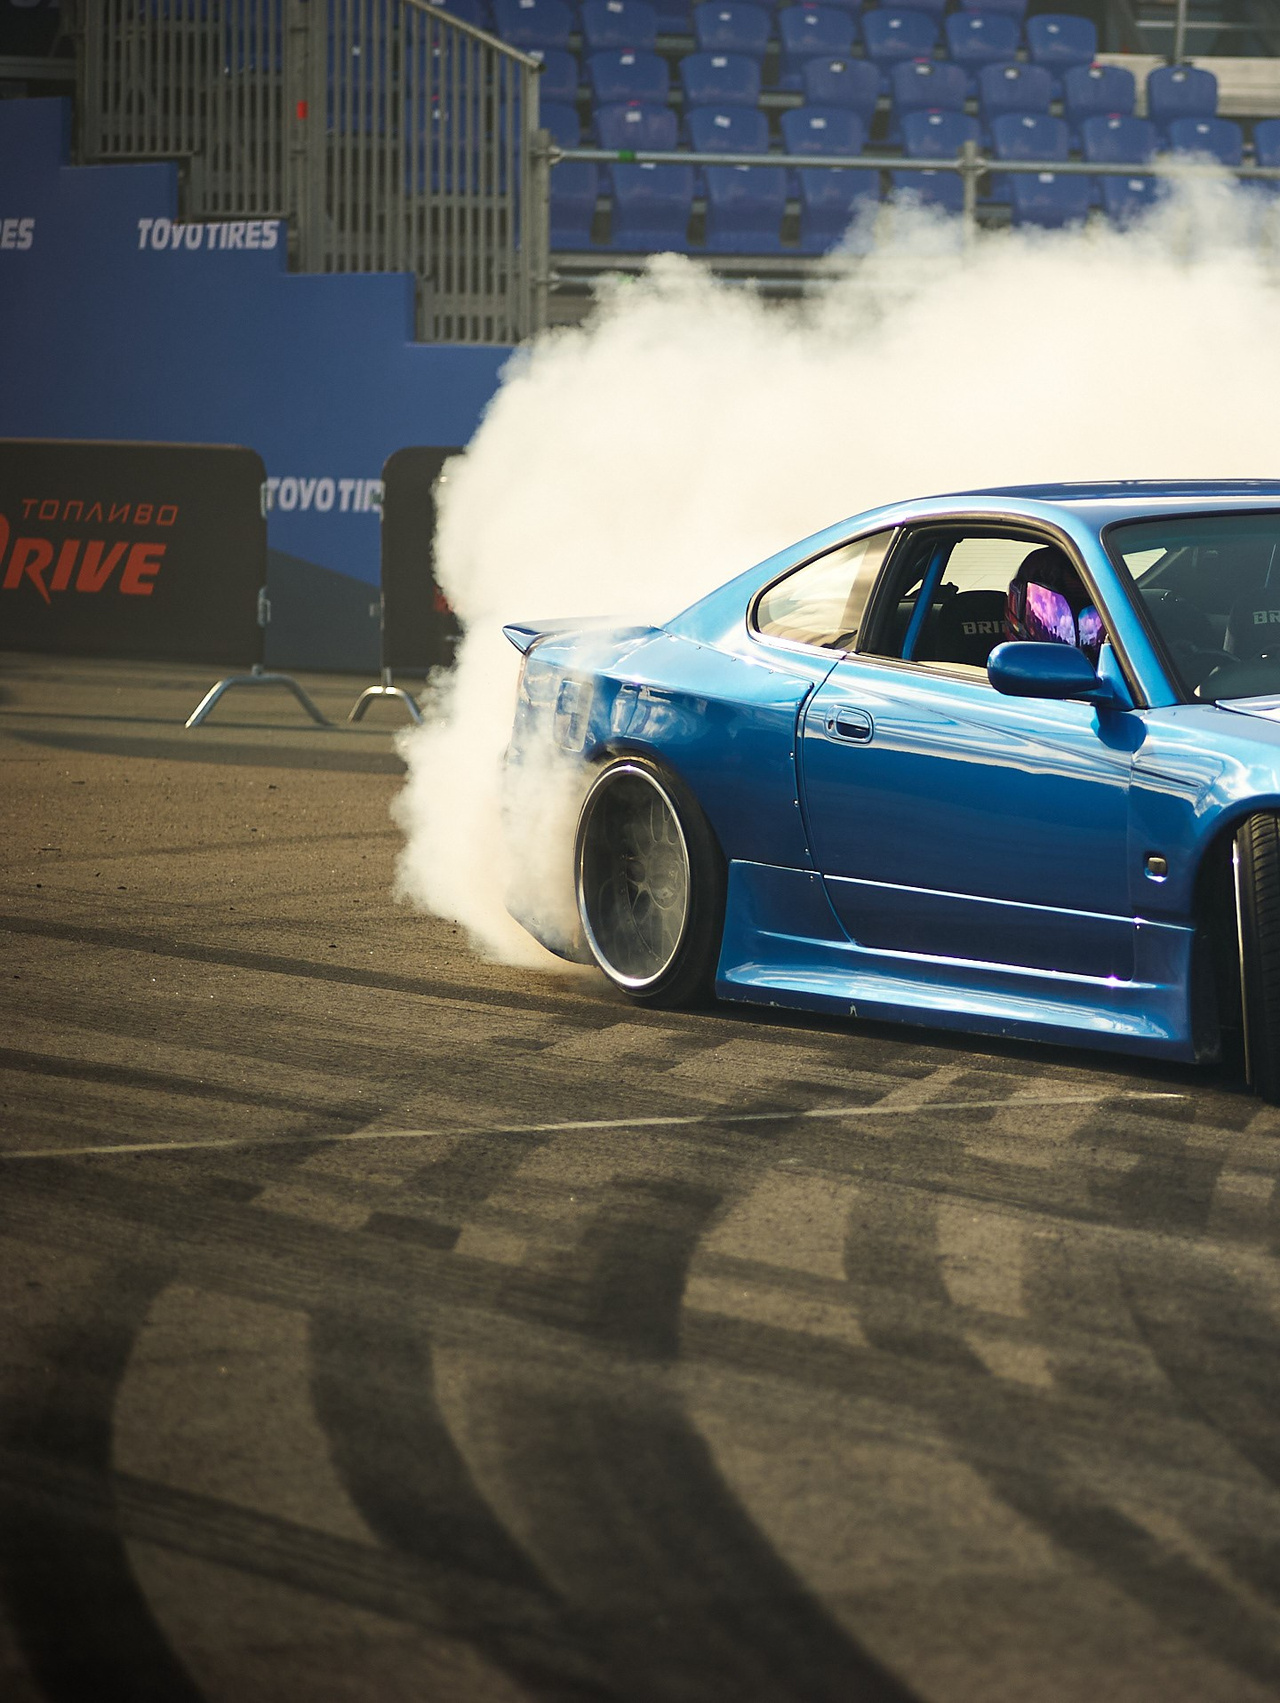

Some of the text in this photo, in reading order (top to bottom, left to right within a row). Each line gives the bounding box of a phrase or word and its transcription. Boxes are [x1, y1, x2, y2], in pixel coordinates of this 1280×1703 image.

[137, 218, 281, 251] TOYO TIRES
[265, 476, 336, 512] TOYO
[22, 499, 179, 527] ТОПЛИВО
